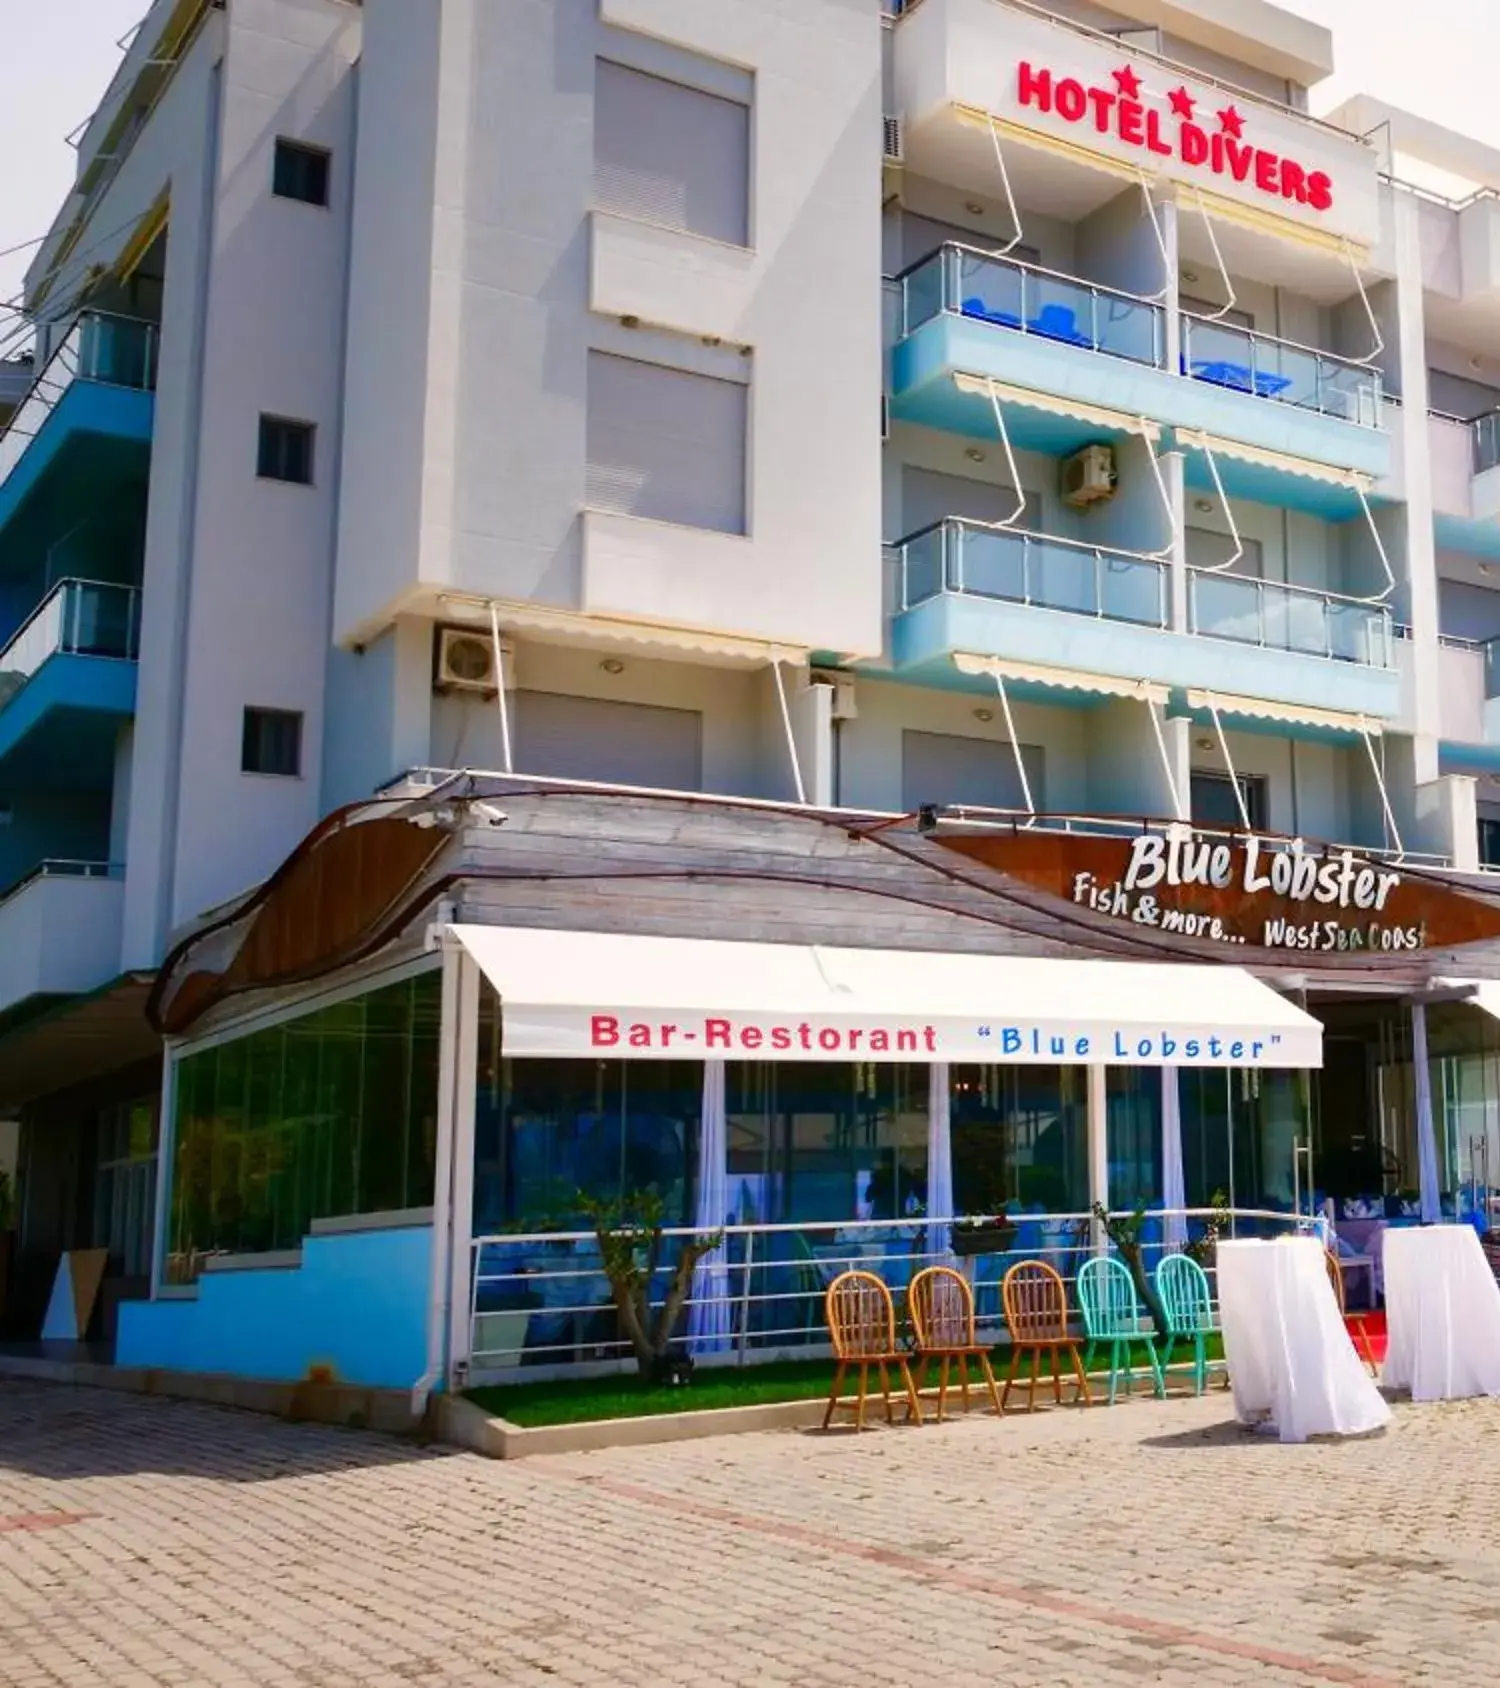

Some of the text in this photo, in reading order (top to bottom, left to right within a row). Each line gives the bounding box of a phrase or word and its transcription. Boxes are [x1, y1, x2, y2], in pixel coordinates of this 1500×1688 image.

[1017, 61, 1333, 210] HOTEL DIVERS
[1124, 823, 1400, 911] Blue Lobster
[1073, 872, 1128, 917] Fish
[1132, 895, 1159, 926] &
[1264, 917, 1428, 950] West Sea Coast
[590, 1015, 937, 1051] Bar-Restorant
